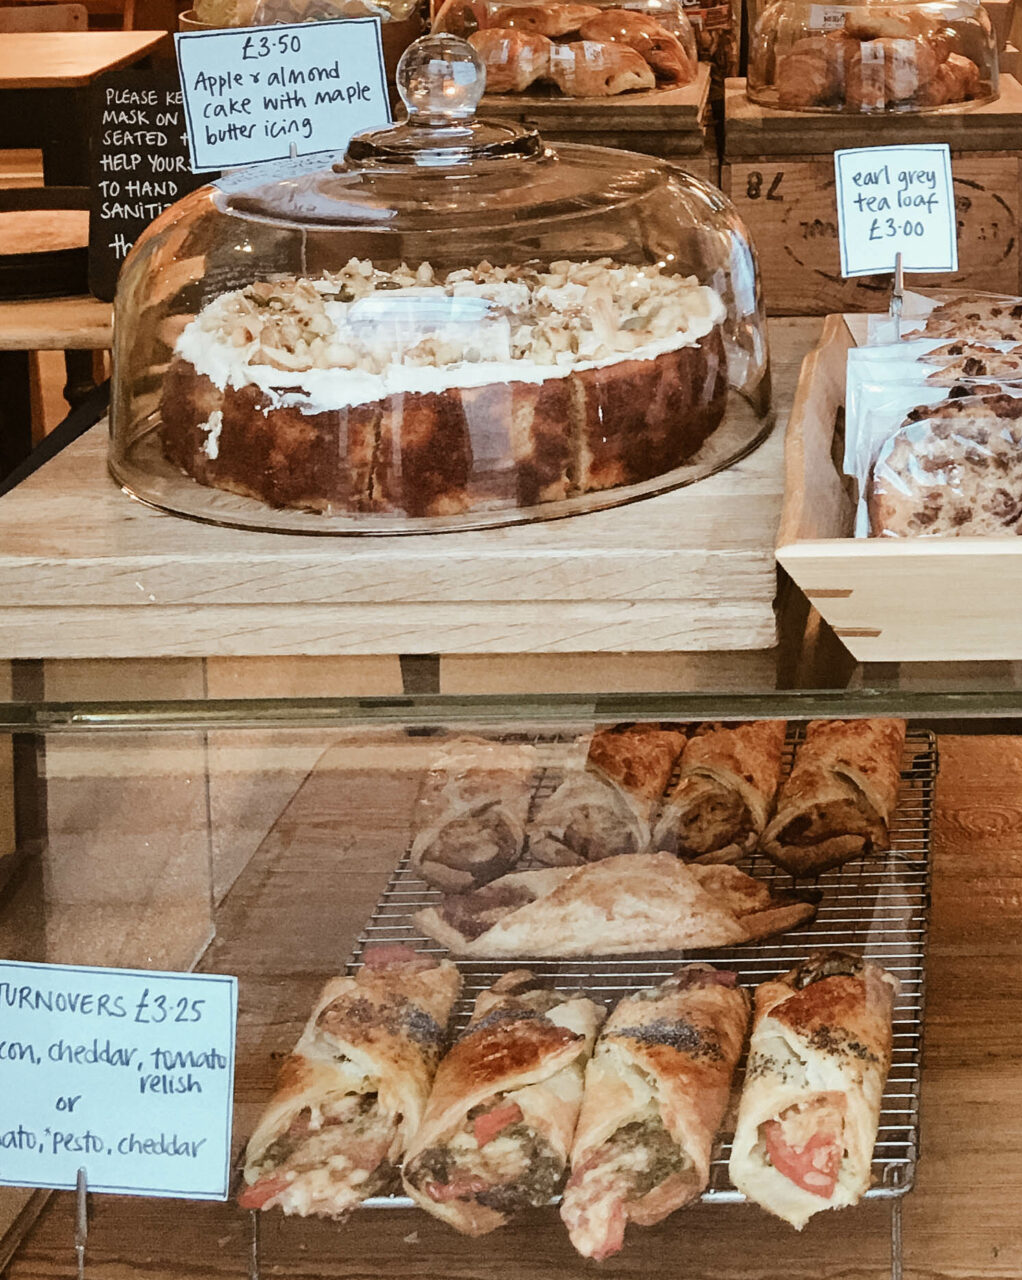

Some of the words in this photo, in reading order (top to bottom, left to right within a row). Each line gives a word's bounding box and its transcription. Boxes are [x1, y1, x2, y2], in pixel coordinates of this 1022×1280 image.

[242, 34, 302, 60] £3.50
[194, 71, 243, 96] Apple
[268, 61, 340, 87] almond
[106, 88, 158, 105] PLEASE
[166, 90, 184, 106] KE
[203, 97, 252, 119] cake
[263, 91, 307, 111] with
[315, 81, 372, 106] maple
[102, 110, 150, 125] MASK
[156, 112, 178, 126] ON
[102, 130, 168, 146] SEATED
[205, 122, 257, 145] butter
[264, 117, 313, 139] icing
[99, 153, 142, 171] HELP
[98, 180, 120, 197] TO
[125, 180, 178, 198] HAND
[852, 165, 890, 187] earl
[898, 168, 937, 191] grey
[853, 192, 891, 212] tea
[897, 190, 939, 214] loaf
[869, 218, 925, 241] £3.00
[134, 988, 206, 1023] £3.25
[48, 1038, 143, 1071] cheddar,
[151, 1047, 227, 1070] tomato
[140, 1074, 202, 1094] relish
[56, 1094, 82, 1112] or
[0, 1125, 44, 1153] ato,
[118, 1133, 207, 1158] cheddar
